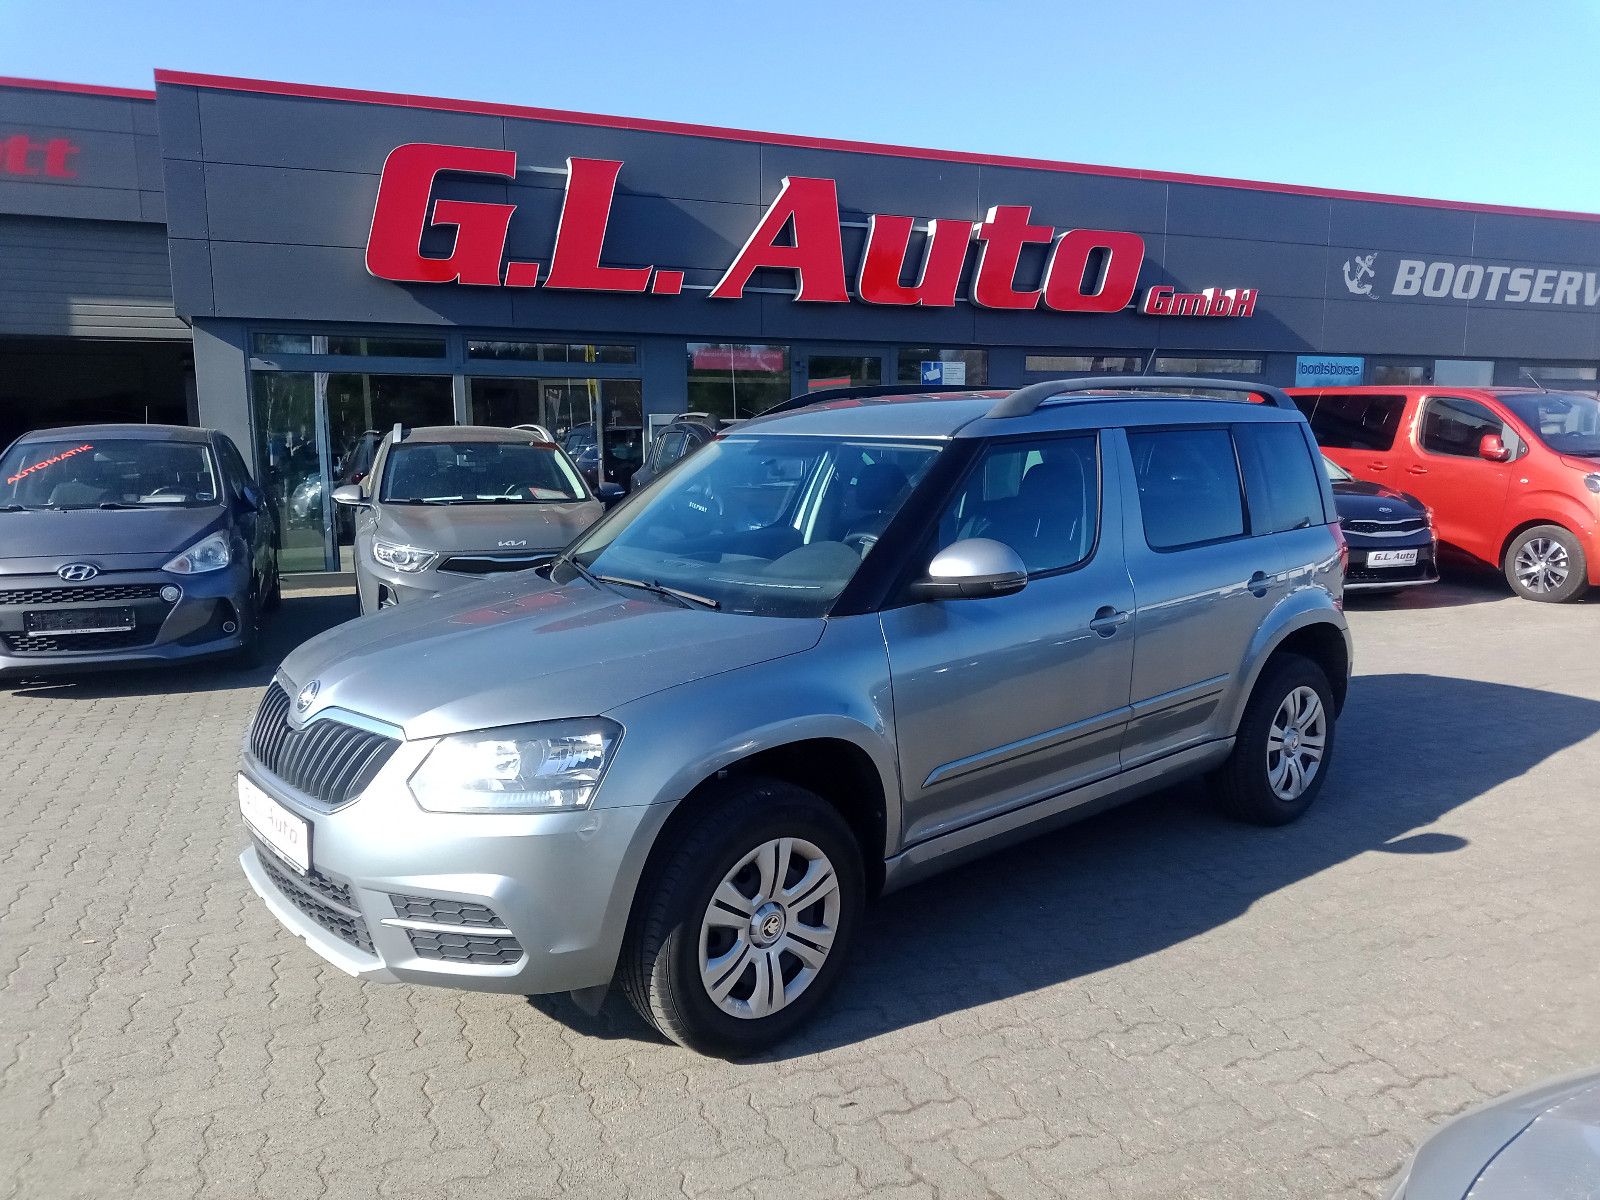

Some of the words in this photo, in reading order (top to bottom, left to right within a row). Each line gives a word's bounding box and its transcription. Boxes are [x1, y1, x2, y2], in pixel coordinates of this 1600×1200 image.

[0, 132, 80, 178] tt
[365, 142, 684, 295] G.L.
[707, 176, 1146, 313] Auto
[1137, 285, 1260, 318] GmbH
[7, 444, 94, 485] AUTOMATIK
[1393, 552, 1416, 560] Auto
